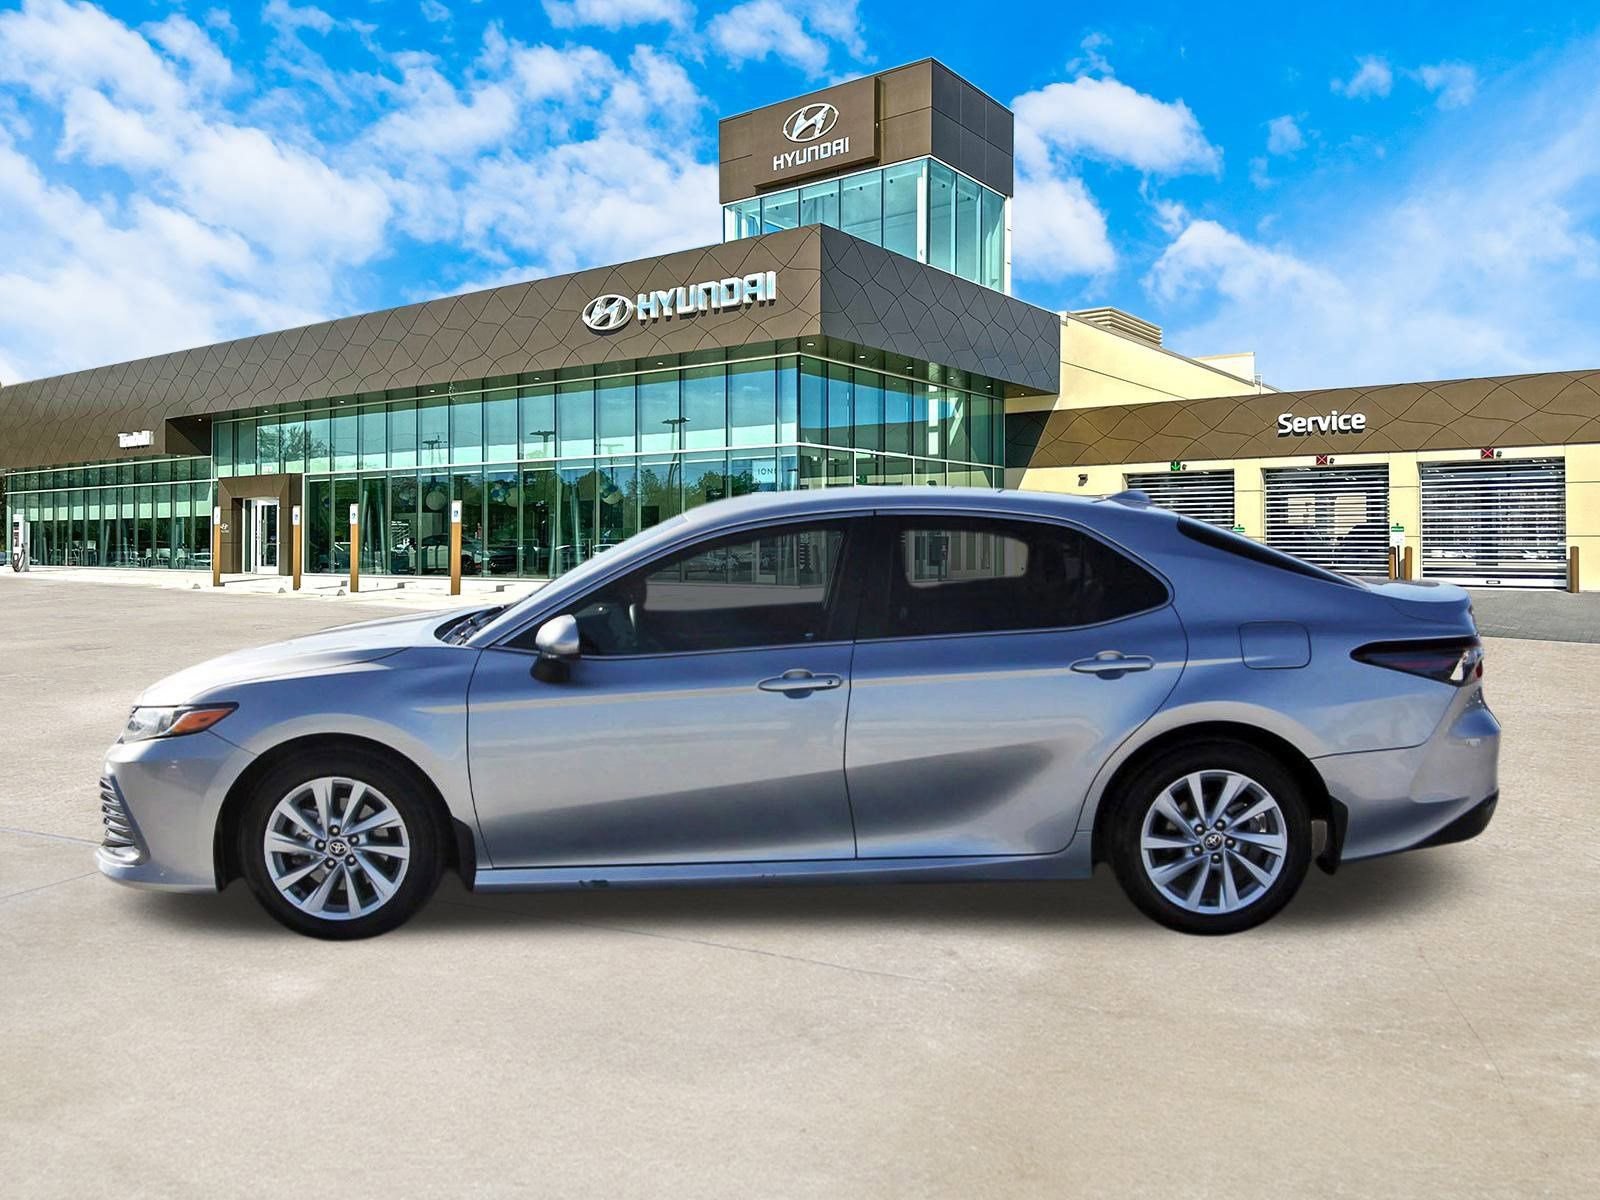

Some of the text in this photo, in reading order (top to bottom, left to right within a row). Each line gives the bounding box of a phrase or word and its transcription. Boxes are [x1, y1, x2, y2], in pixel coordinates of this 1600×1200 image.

[773, 137, 849, 171] HYUNDAI
[637, 270, 777, 321] HYUNDAI
[1277, 410, 1366, 435] Service
